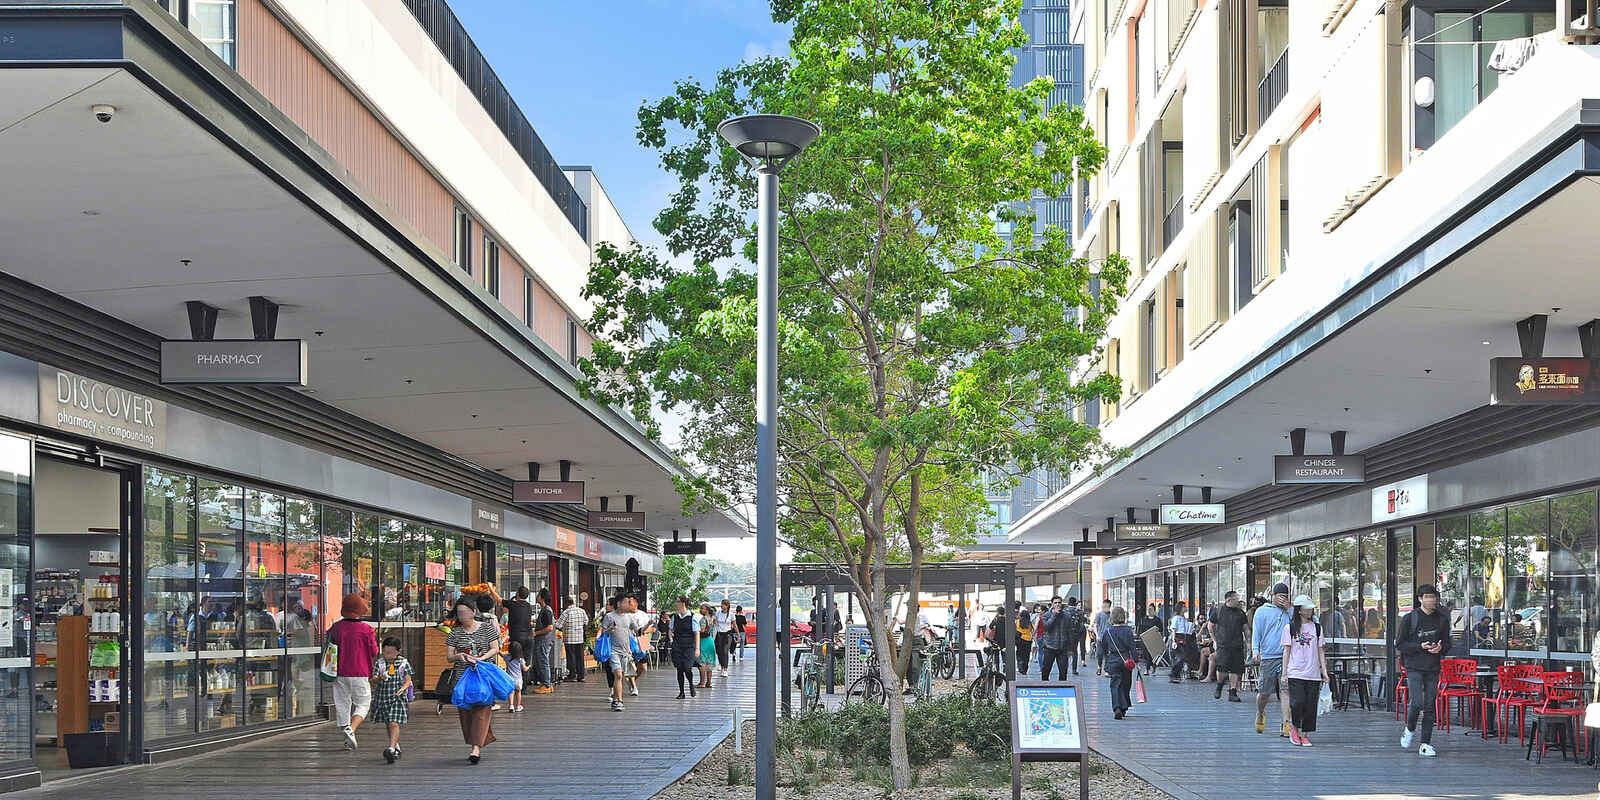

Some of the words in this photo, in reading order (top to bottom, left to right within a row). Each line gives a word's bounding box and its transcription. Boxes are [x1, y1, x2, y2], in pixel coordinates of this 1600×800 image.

[197, 353, 263, 365] PHARMACY
[57, 372, 154, 427] DISCOVER
[57, 408, 97, 433] pharmacy
[107, 425, 154, 449] compounding
[1303, 459, 1337, 467] CHINESE
[1295, 468, 1345, 477] RESTAURANT
[1178, 510, 1217, 520] Chatime
